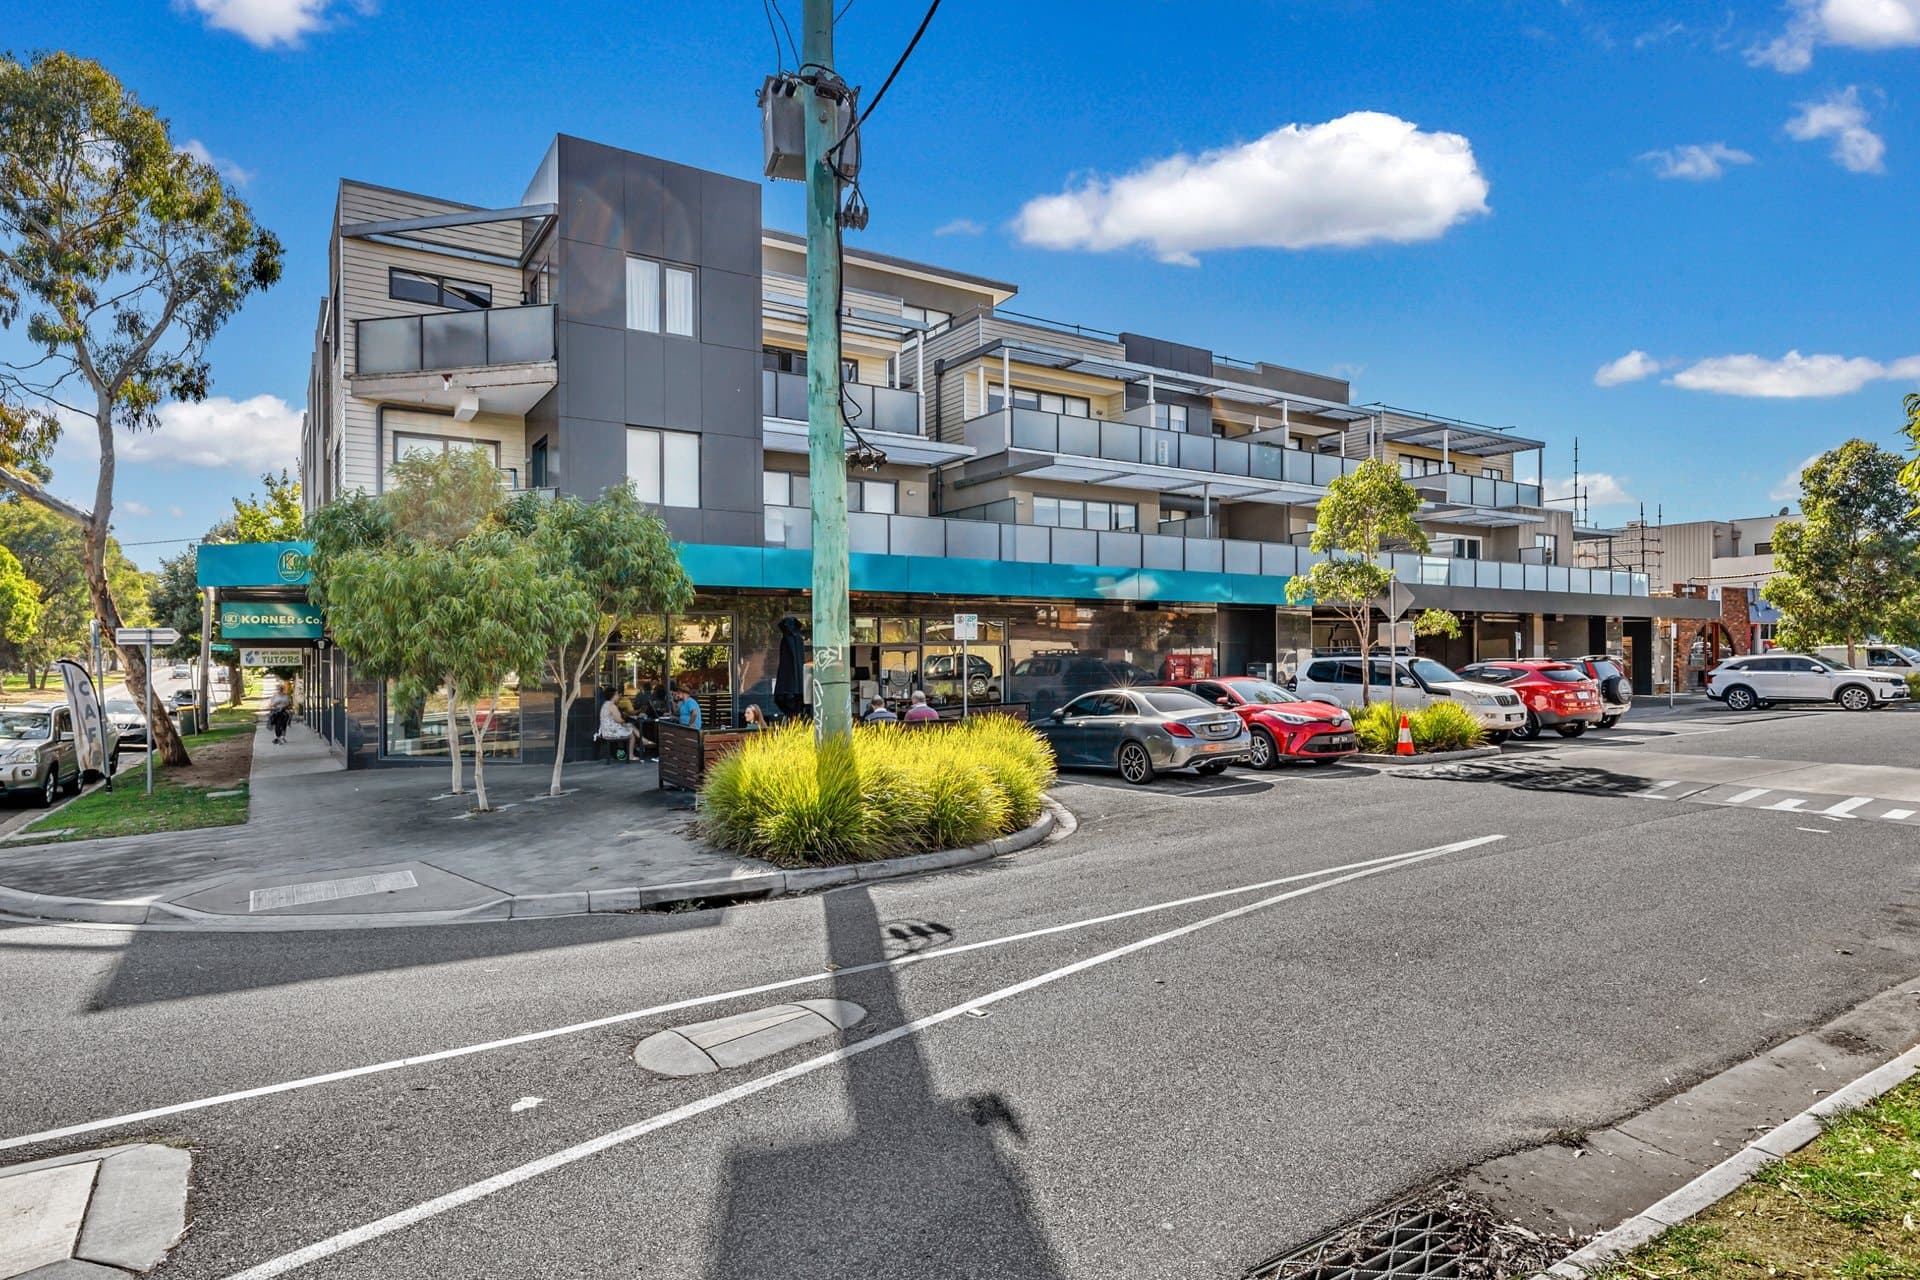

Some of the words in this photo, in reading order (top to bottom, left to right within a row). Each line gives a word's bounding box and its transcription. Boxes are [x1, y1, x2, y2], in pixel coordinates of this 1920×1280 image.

[241, 615, 295, 624] KORNER
[297, 617, 304, 625] &
[262, 656, 301, 664] TUTORS
